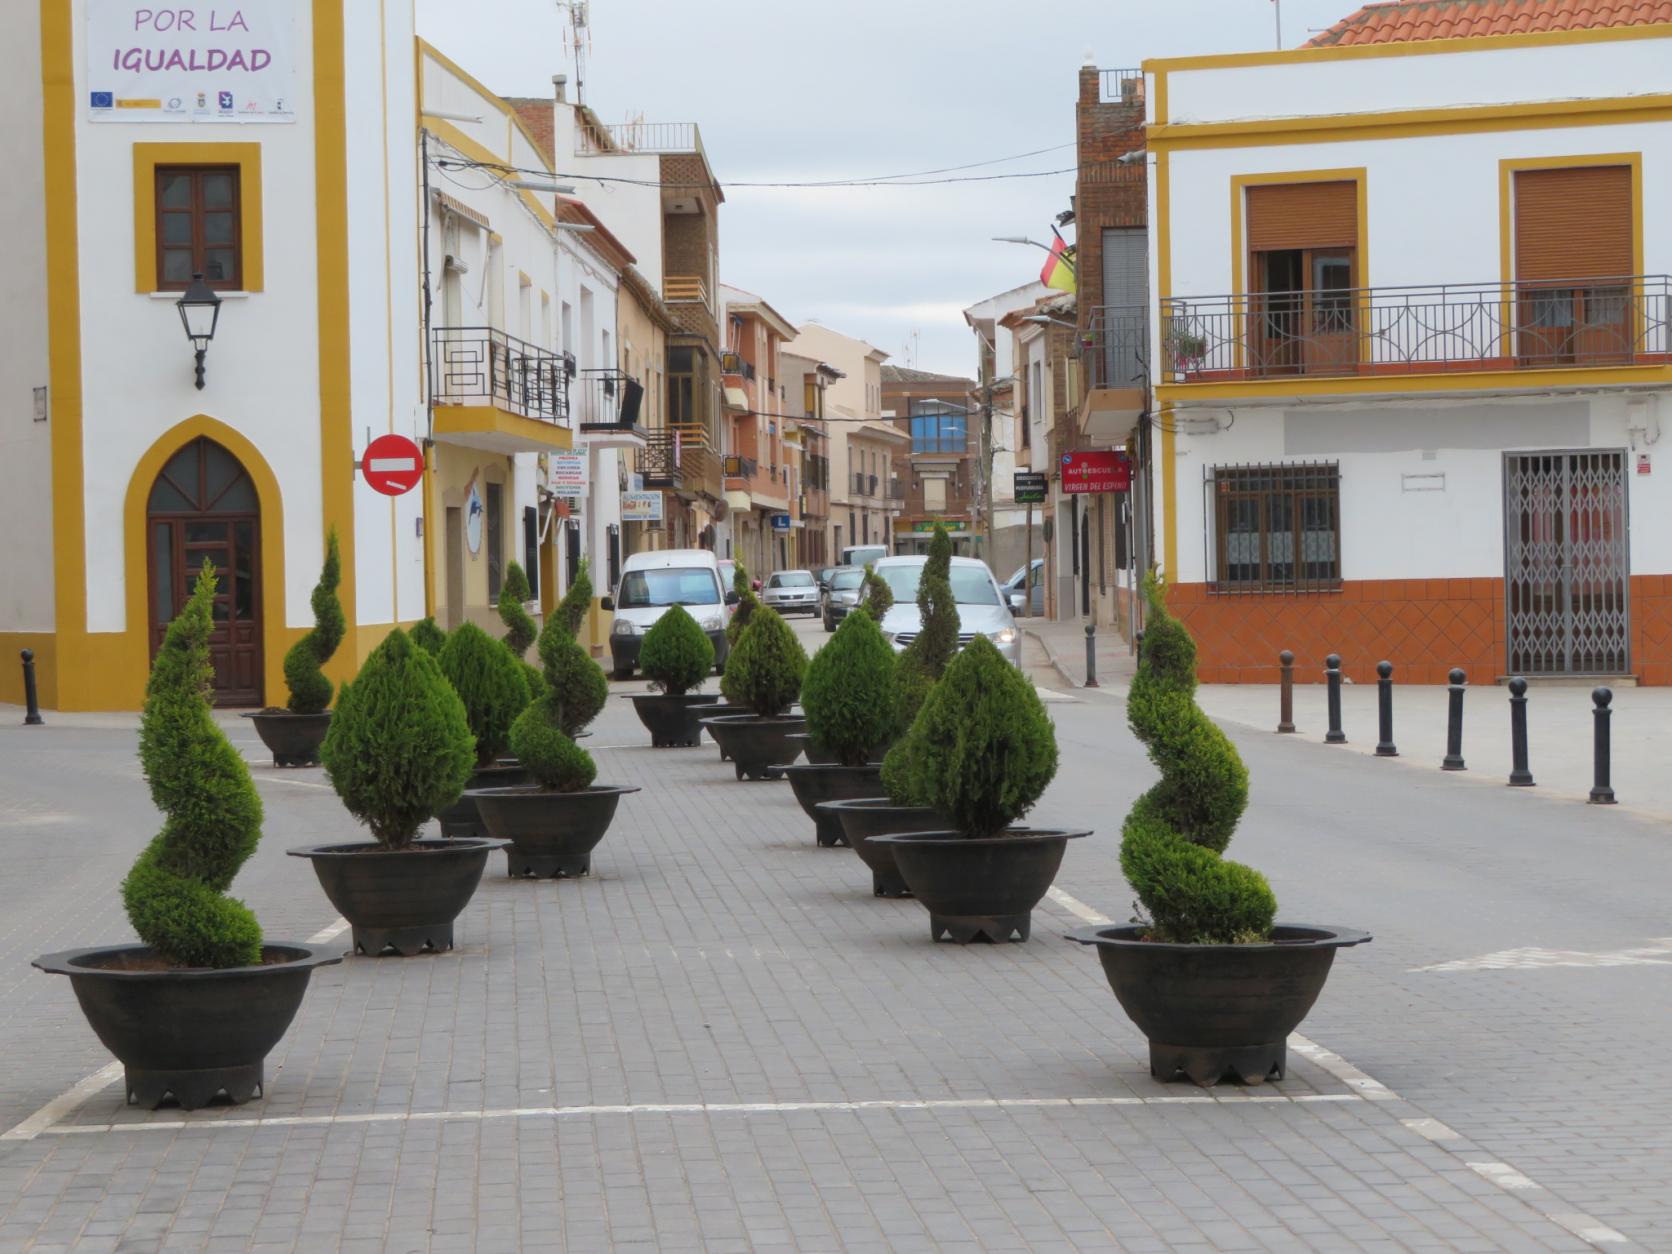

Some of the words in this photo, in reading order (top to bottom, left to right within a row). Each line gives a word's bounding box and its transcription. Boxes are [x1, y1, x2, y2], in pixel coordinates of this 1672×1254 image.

[134, 9, 196, 32] POR
[209, 10, 249, 32] LA
[112, 47, 272, 74] IGUALDAD
[1064, 481, 1089, 491] VIRGEN
[1090, 482, 1101, 491] DEL
